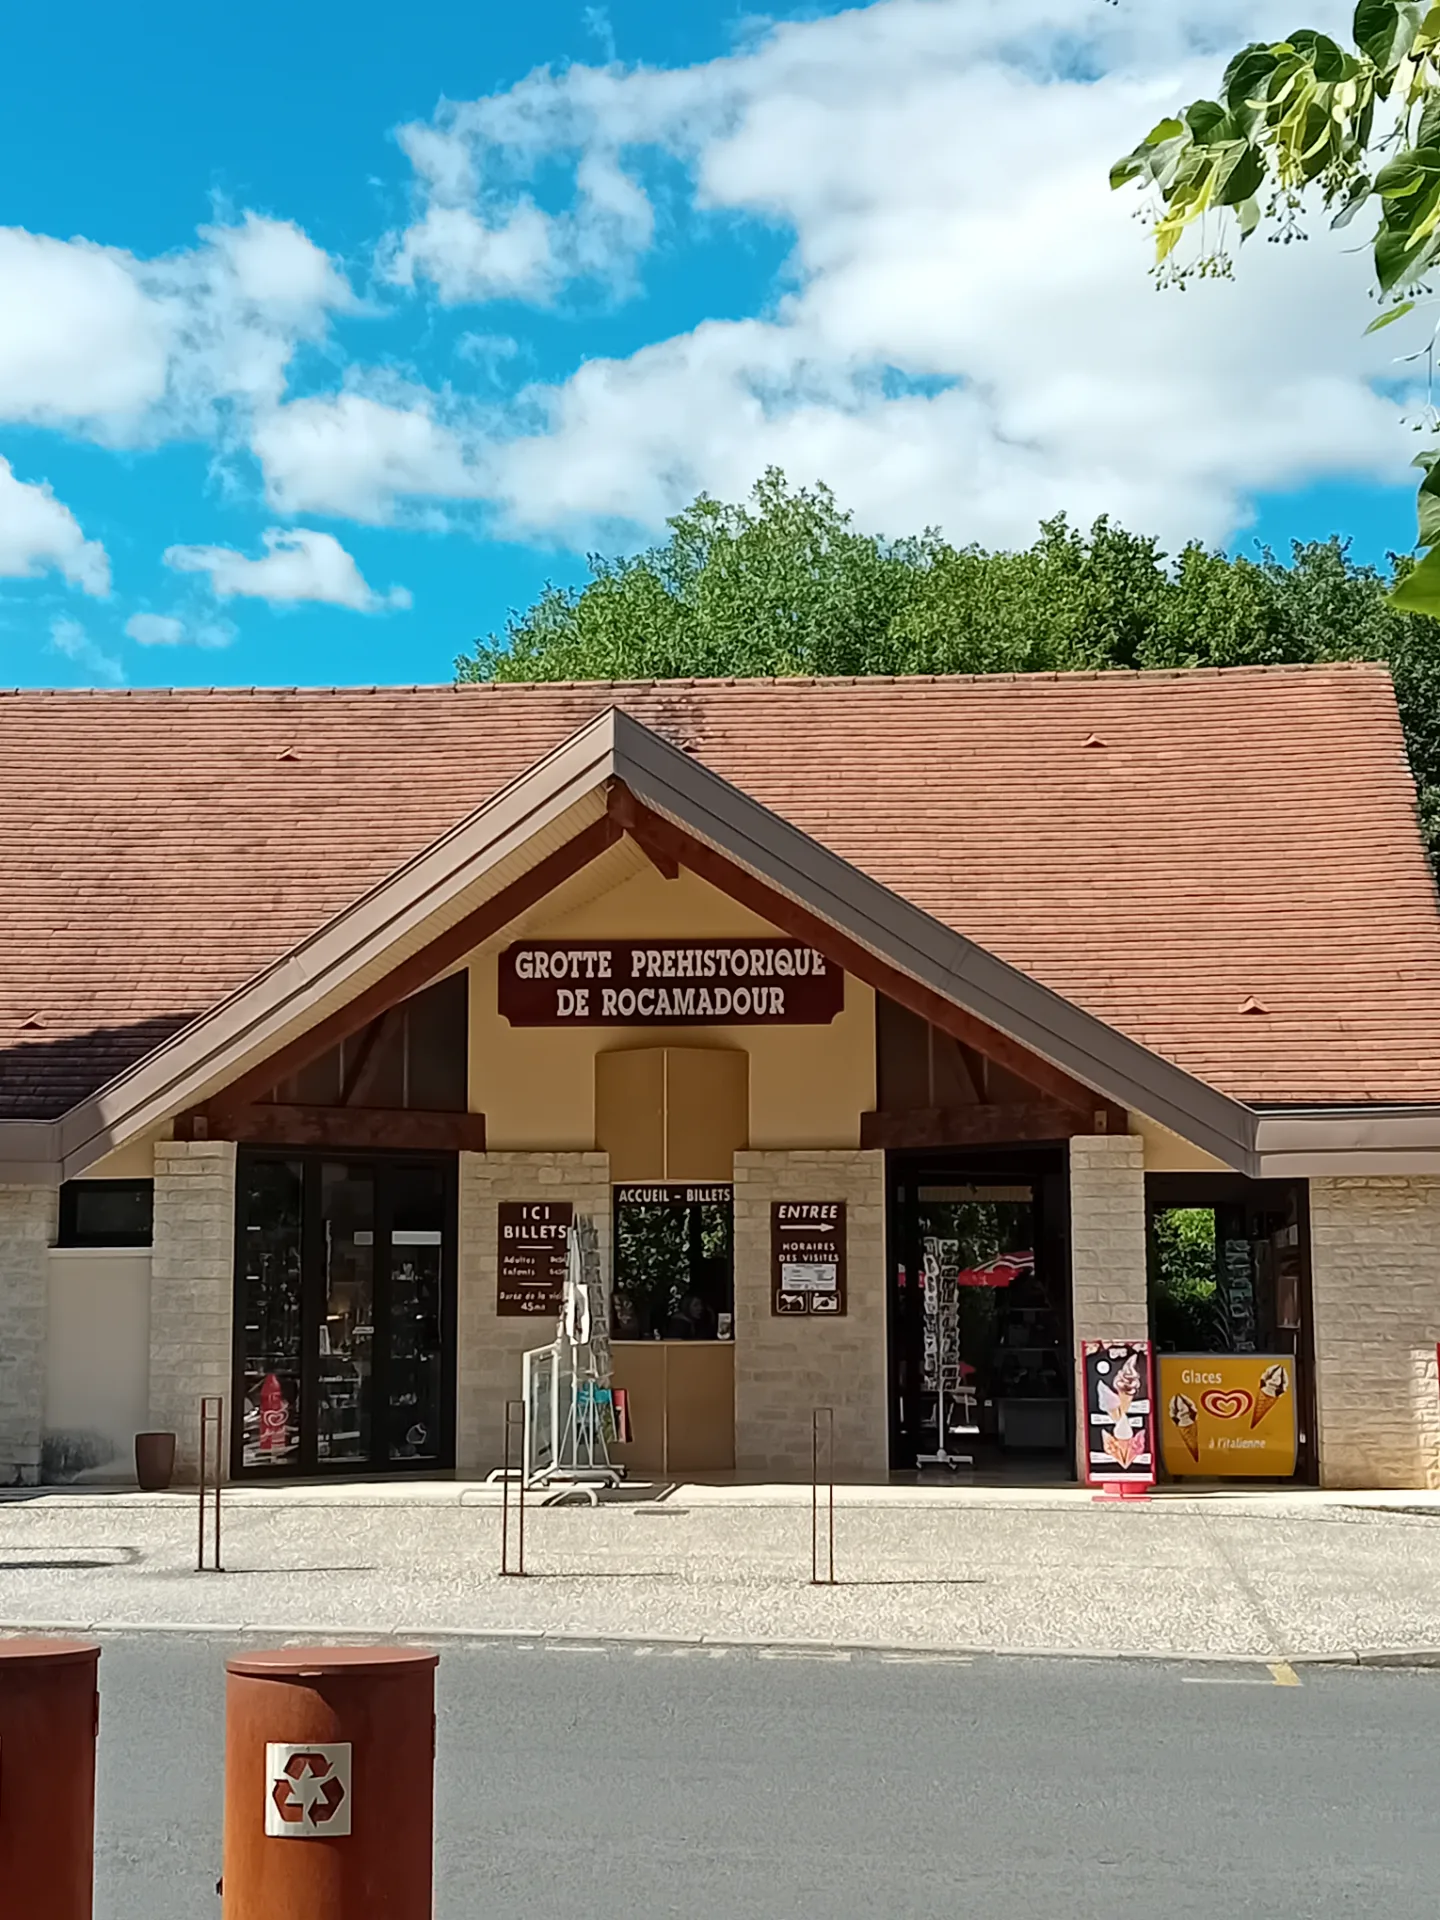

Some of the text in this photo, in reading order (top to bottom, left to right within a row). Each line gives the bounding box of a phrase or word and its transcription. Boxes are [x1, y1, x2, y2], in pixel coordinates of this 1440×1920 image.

[515, 948, 826, 979] GROTTE PREHISTORIQUE
[556, 987, 785, 1016] DE ROCAMADOUR
[619, 1188, 670, 1202] ACCUEIL
[686, 1188, 730, 1202] BILLETS
[522, 1206, 549, 1220] ICI
[778, 1205, 838, 1219] ENTREE
[504, 1225, 567, 1239] BILLETS
[782, 1242, 836, 1251] HORAIRES
[778, 1254, 839, 1262] DES VISITES
[1181, 1369, 1222, 1384] Glaces
[1209, 1437, 1266, 1449] à l'italienne
